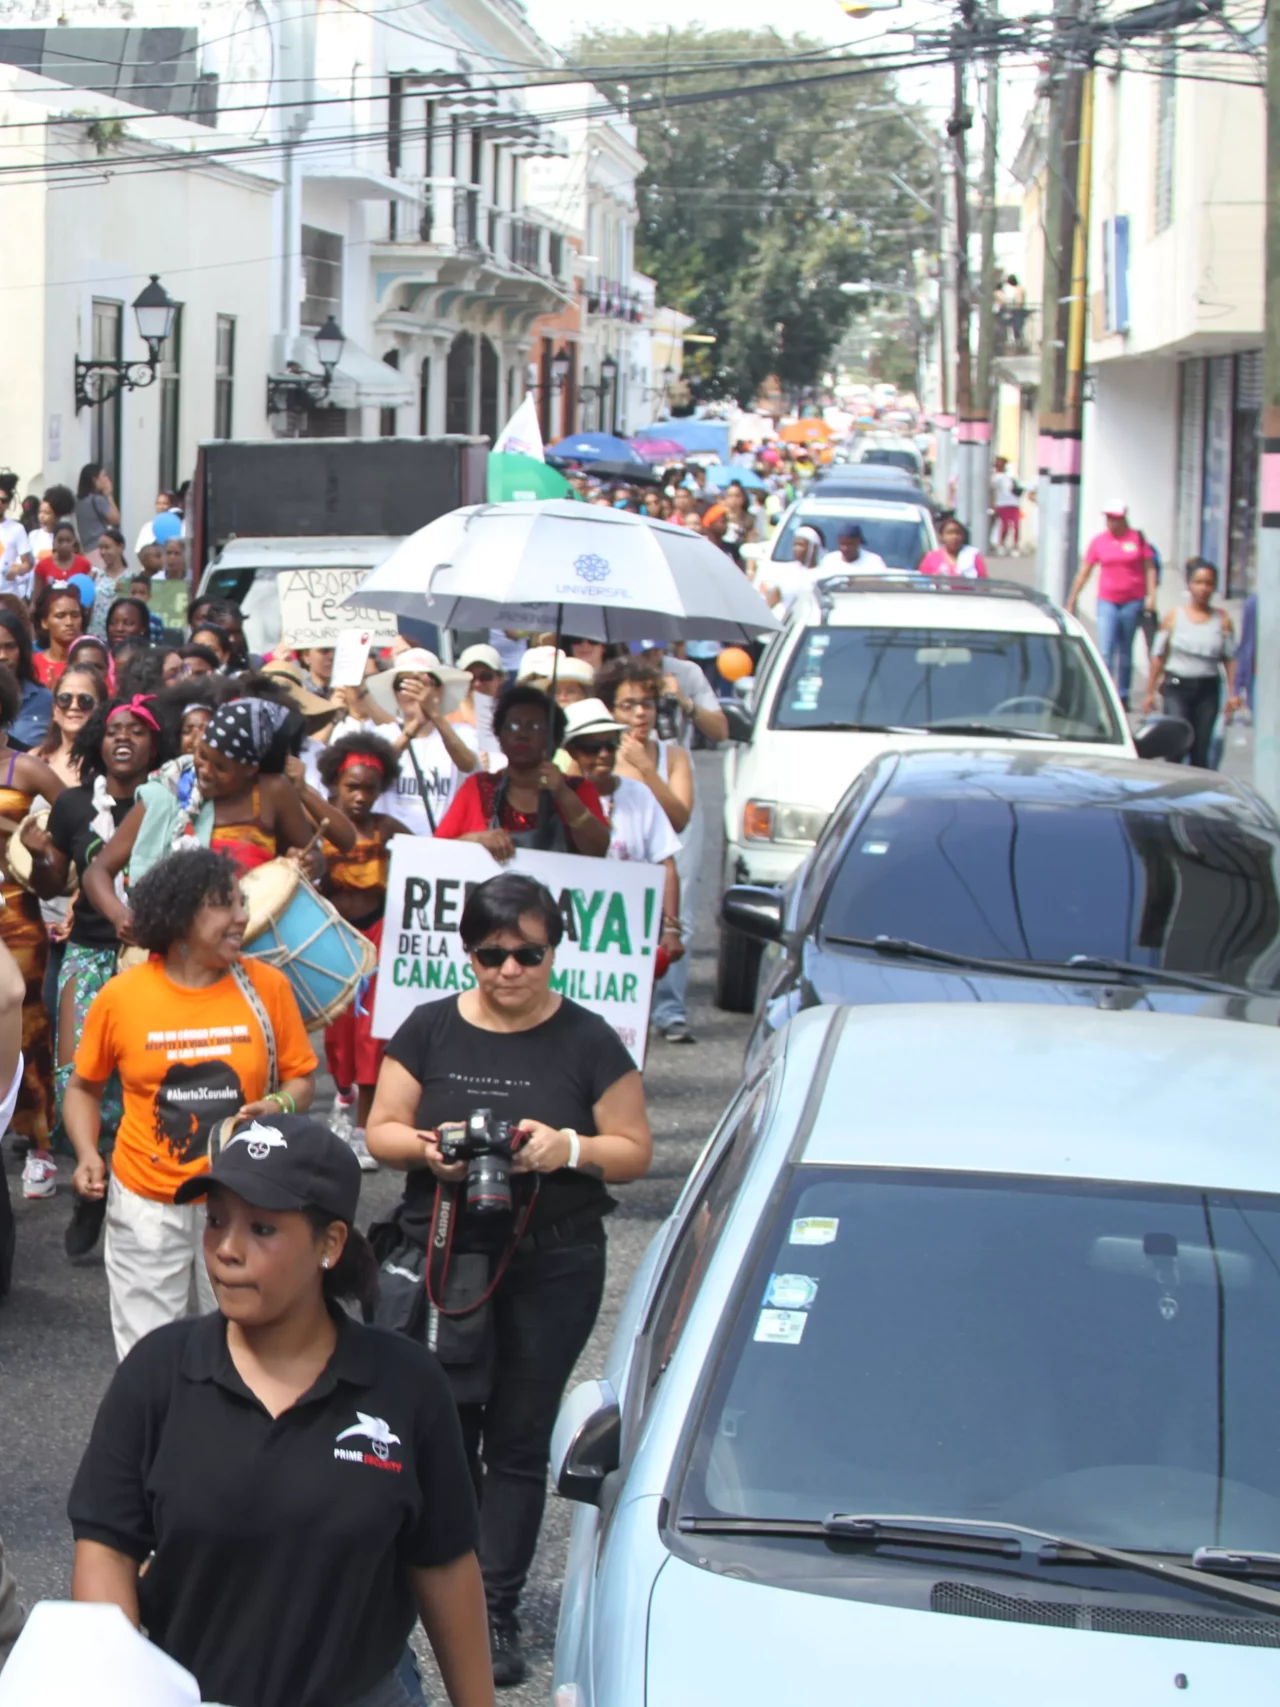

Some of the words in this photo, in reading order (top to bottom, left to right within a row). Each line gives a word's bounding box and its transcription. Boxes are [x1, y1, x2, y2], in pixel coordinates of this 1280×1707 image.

[283, 570, 364, 600] ABORT
[556, 583, 633, 599] UNIVERSAL
[398, 934, 421, 956] DE
[426, 935, 449, 958] LA
[166, 1086, 238, 1101] #Aborto3Causales
[434, 1201, 451, 1248] Canon
